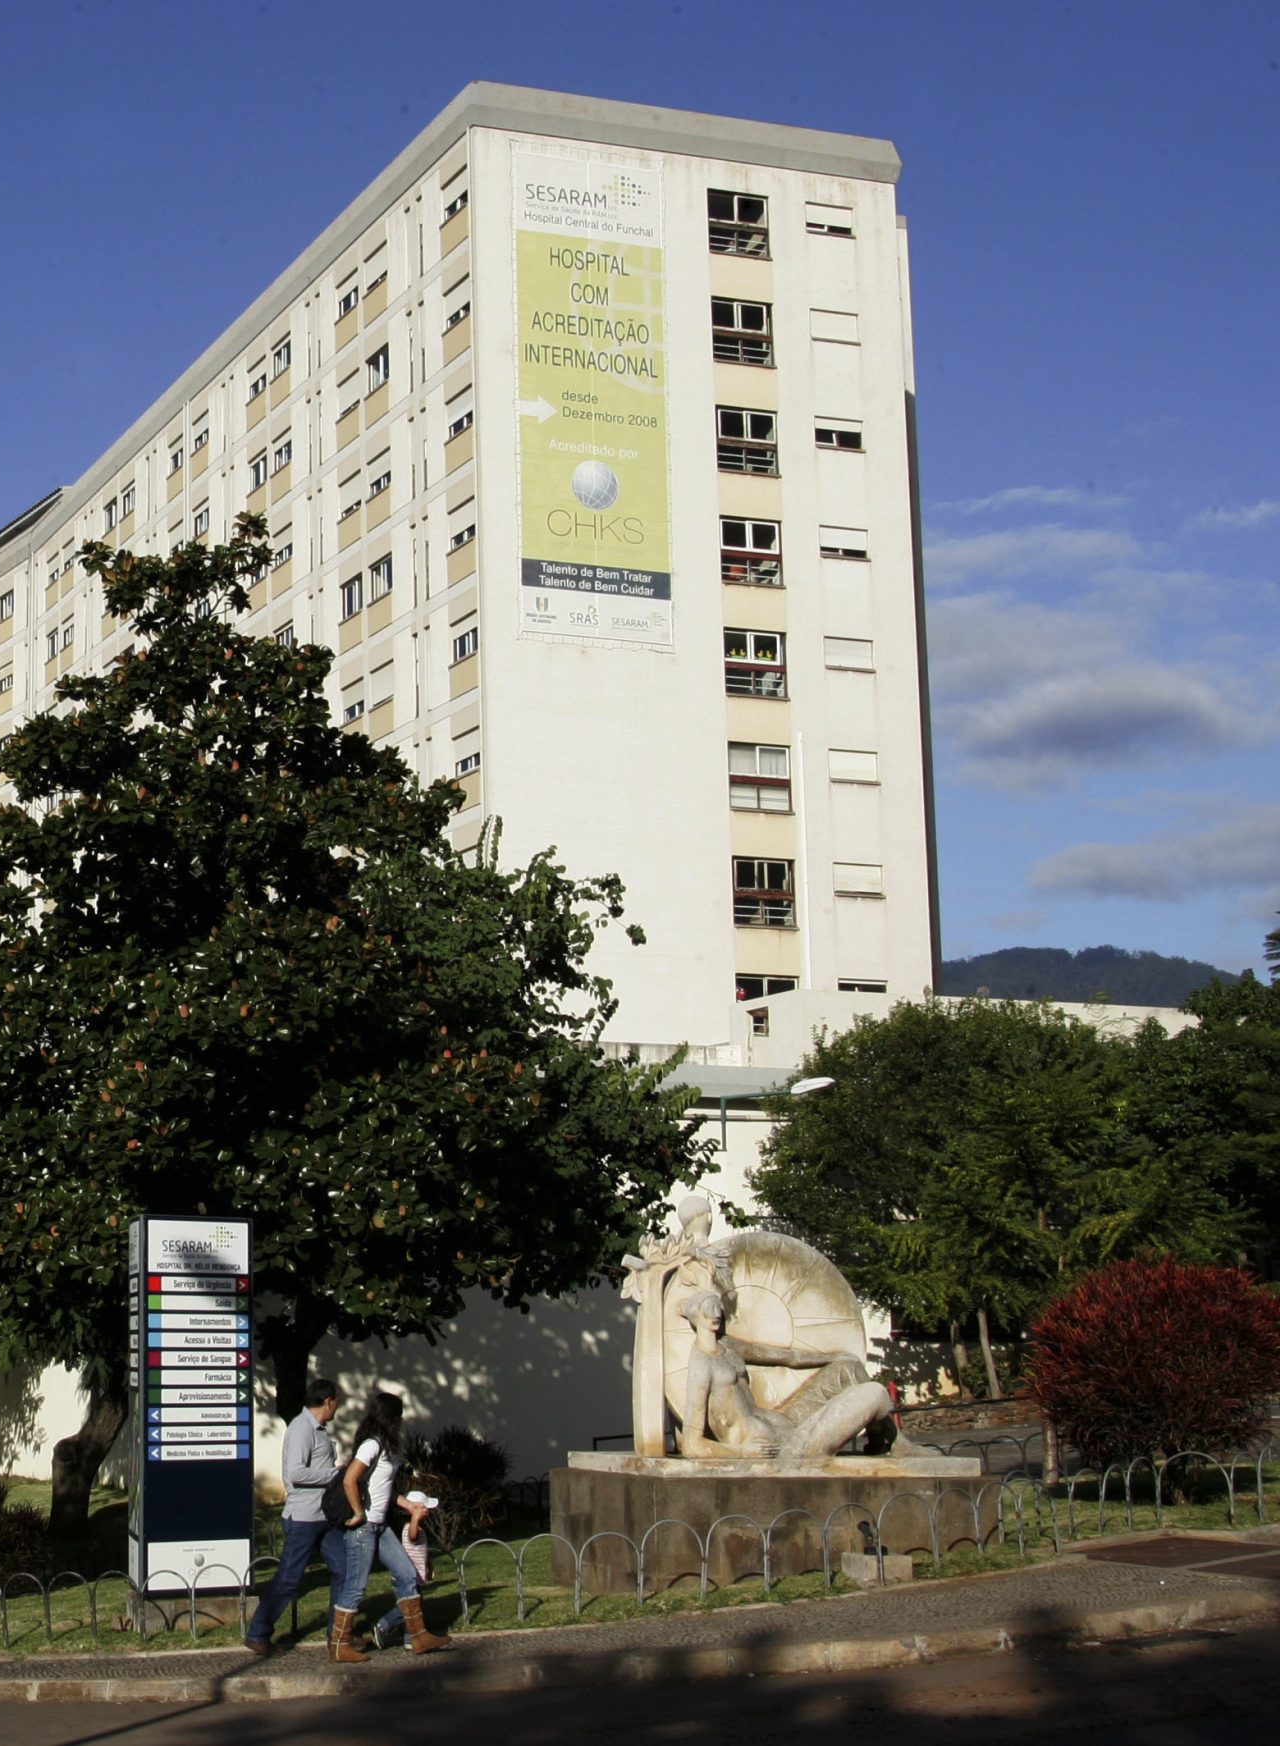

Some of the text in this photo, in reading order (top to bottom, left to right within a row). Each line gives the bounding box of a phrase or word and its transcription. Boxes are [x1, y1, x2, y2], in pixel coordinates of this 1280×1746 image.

[525, 183, 607, 210] SESARAM
[524, 210, 562, 225] Hospital
[565, 216, 599, 230] Central
[601, 221, 613, 232] do
[616, 223, 653, 238] Funchal
[549, 246, 630, 277] HOSPITAL
[570, 282, 609, 306] COM
[531, 310, 650, 347] ACREDITAÇÃO
[524, 343, 659, 379] INTERNACIONAL
[561, 390, 599, 405] desde
[562, 406, 658, 428] Dezembro 2008
[548, 438, 640, 461] Acreditado por
[546, 508, 645, 545] CHKS
[541, 562, 652, 583] Talento de Bem Tratar
[538, 575, 655, 597] Talento de Bem Cuidar
[568, 611, 599, 625] SRAS
[611, 616, 648, 629] SESARAM
[161, 1239, 212, 1253] SESARAM
[157, 1262, 182, 1270] HOSPITAL
[173, 1280, 195, 1290] Serviço
[197, 1280, 204, 1288] de
[189, 1317, 231, 1326] Internamentos
[184, 1336, 206, 1344] Acesso
[212, 1336, 231, 1344] Visitas
[177, 1354, 231, 1364] Serviço de Sangue
[204, 1373, 231, 1382] Farmácia
